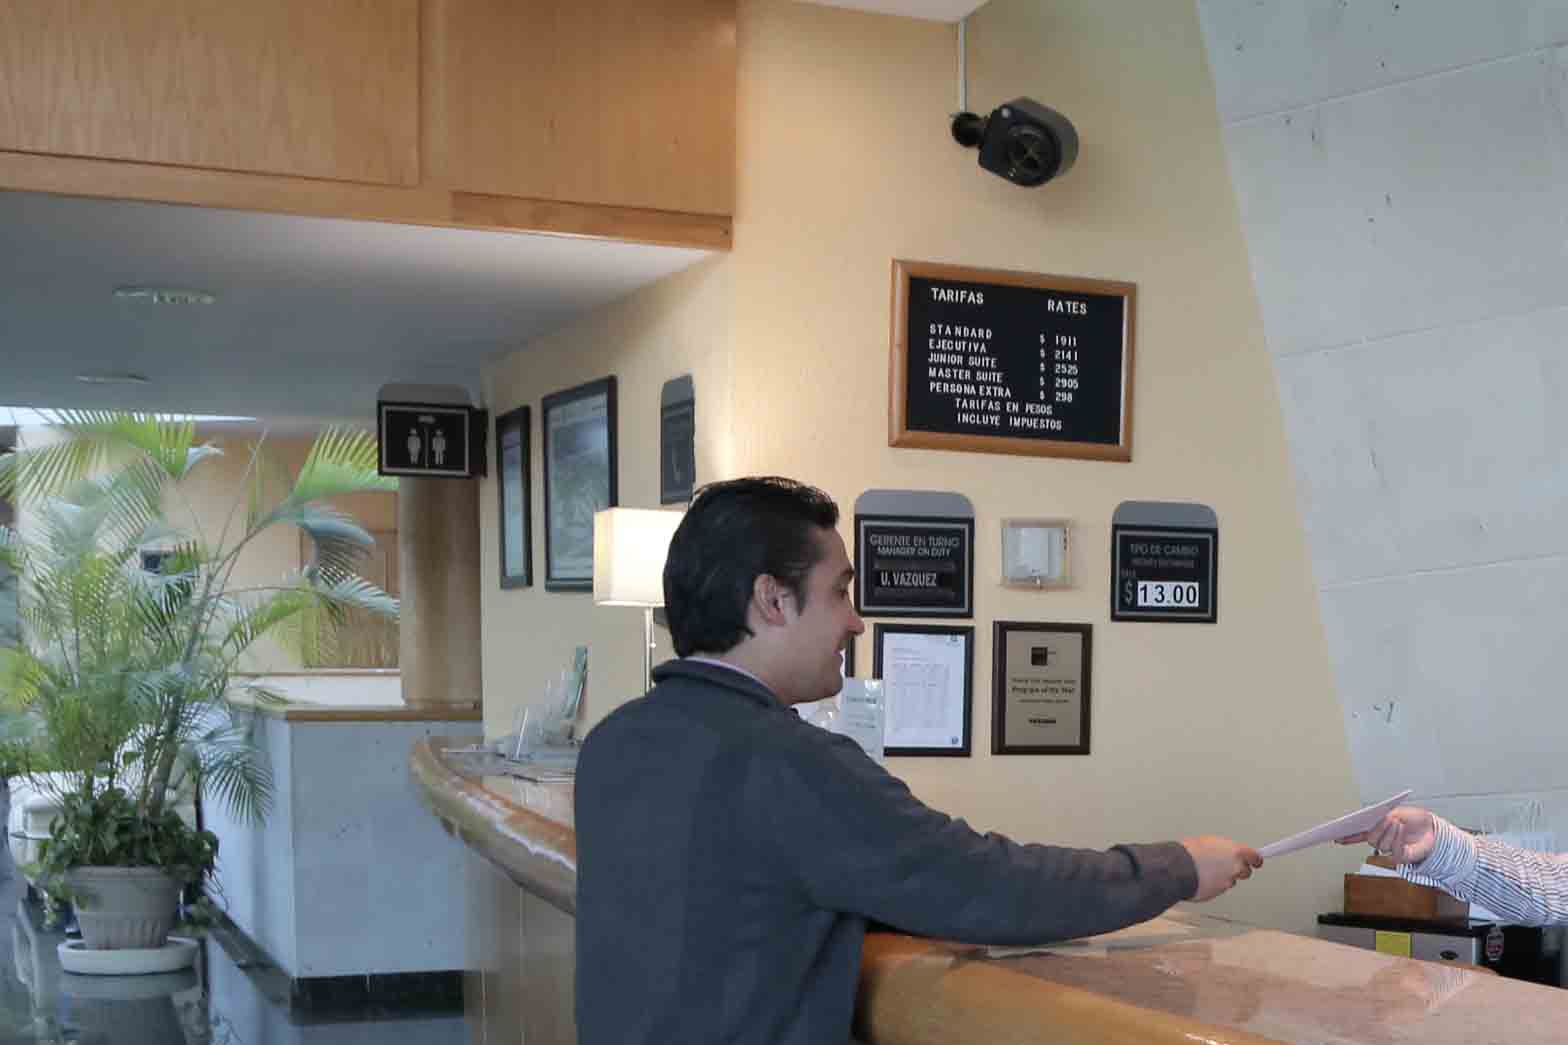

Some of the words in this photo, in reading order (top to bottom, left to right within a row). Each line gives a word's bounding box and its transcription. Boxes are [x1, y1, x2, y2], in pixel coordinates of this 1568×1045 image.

[931, 287, 984, 304] TARIFAS
[1047, 298, 1087, 315] RATES
[929, 324, 992, 339] STANDARD
[1055, 335, 1078, 347] 1911
[928, 338, 987, 353] EJECUTIVA
[1055, 349, 1079, 361] 2141
[927, 352, 964, 366] JUNIOR
[968, 355, 998, 369] SUITE
[928, 366, 971, 380] MASTER
[975, 370, 1004, 384] SUITE
[929, 381, 977, 395] PERSONA
[979, 384, 1012, 399] EXTRA
[955, 398, 1001, 412] TARIFAS
[1006, 401, 1019, 413] EN
[1025, 402, 1054, 416] PESOS
[956, 412, 1001, 427] INCLUYE
[1009, 415, 1063, 431] IMPUESTOS
[893, 570, 937, 588] VAZQUEZ
[1139, 583, 1198, 605] 13.00
